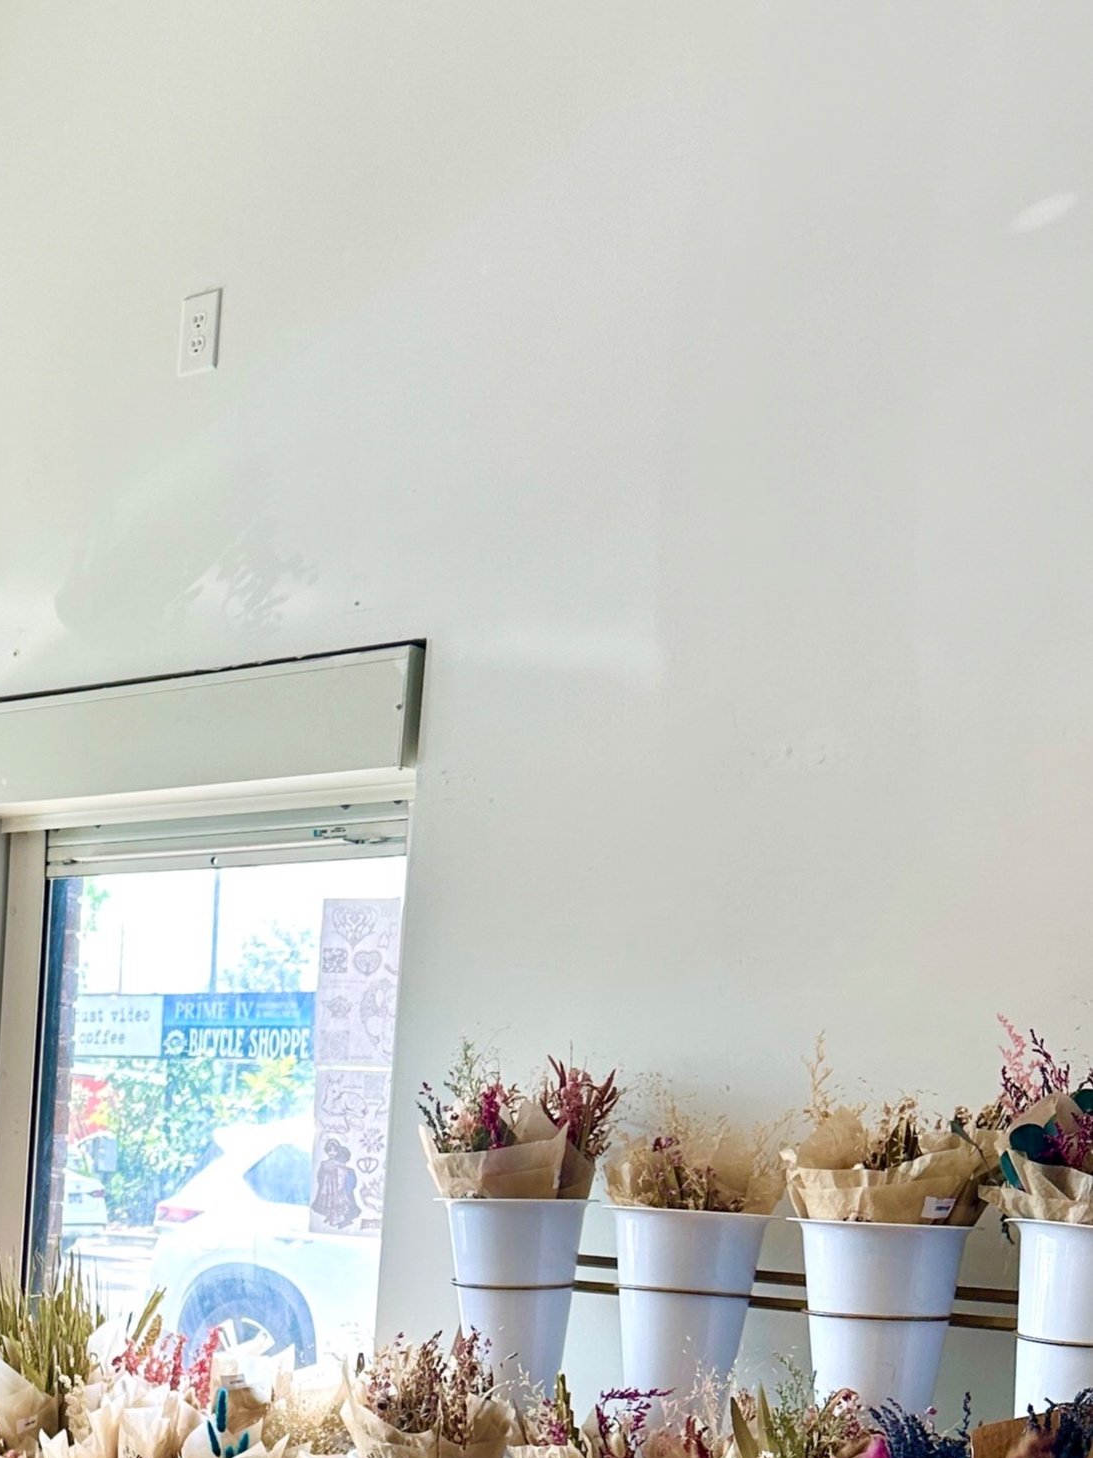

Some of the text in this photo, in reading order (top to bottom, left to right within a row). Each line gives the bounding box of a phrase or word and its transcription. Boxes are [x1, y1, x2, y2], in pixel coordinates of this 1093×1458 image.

[111, 1008, 150, 1023] video
[174, 1001, 228, 1020] PRIME
[234, 1001, 255, 1020] IV
[79, 1030, 126, 1045] coffee
[189, 1027, 310, 1059] BICYCLE SHOPPE
